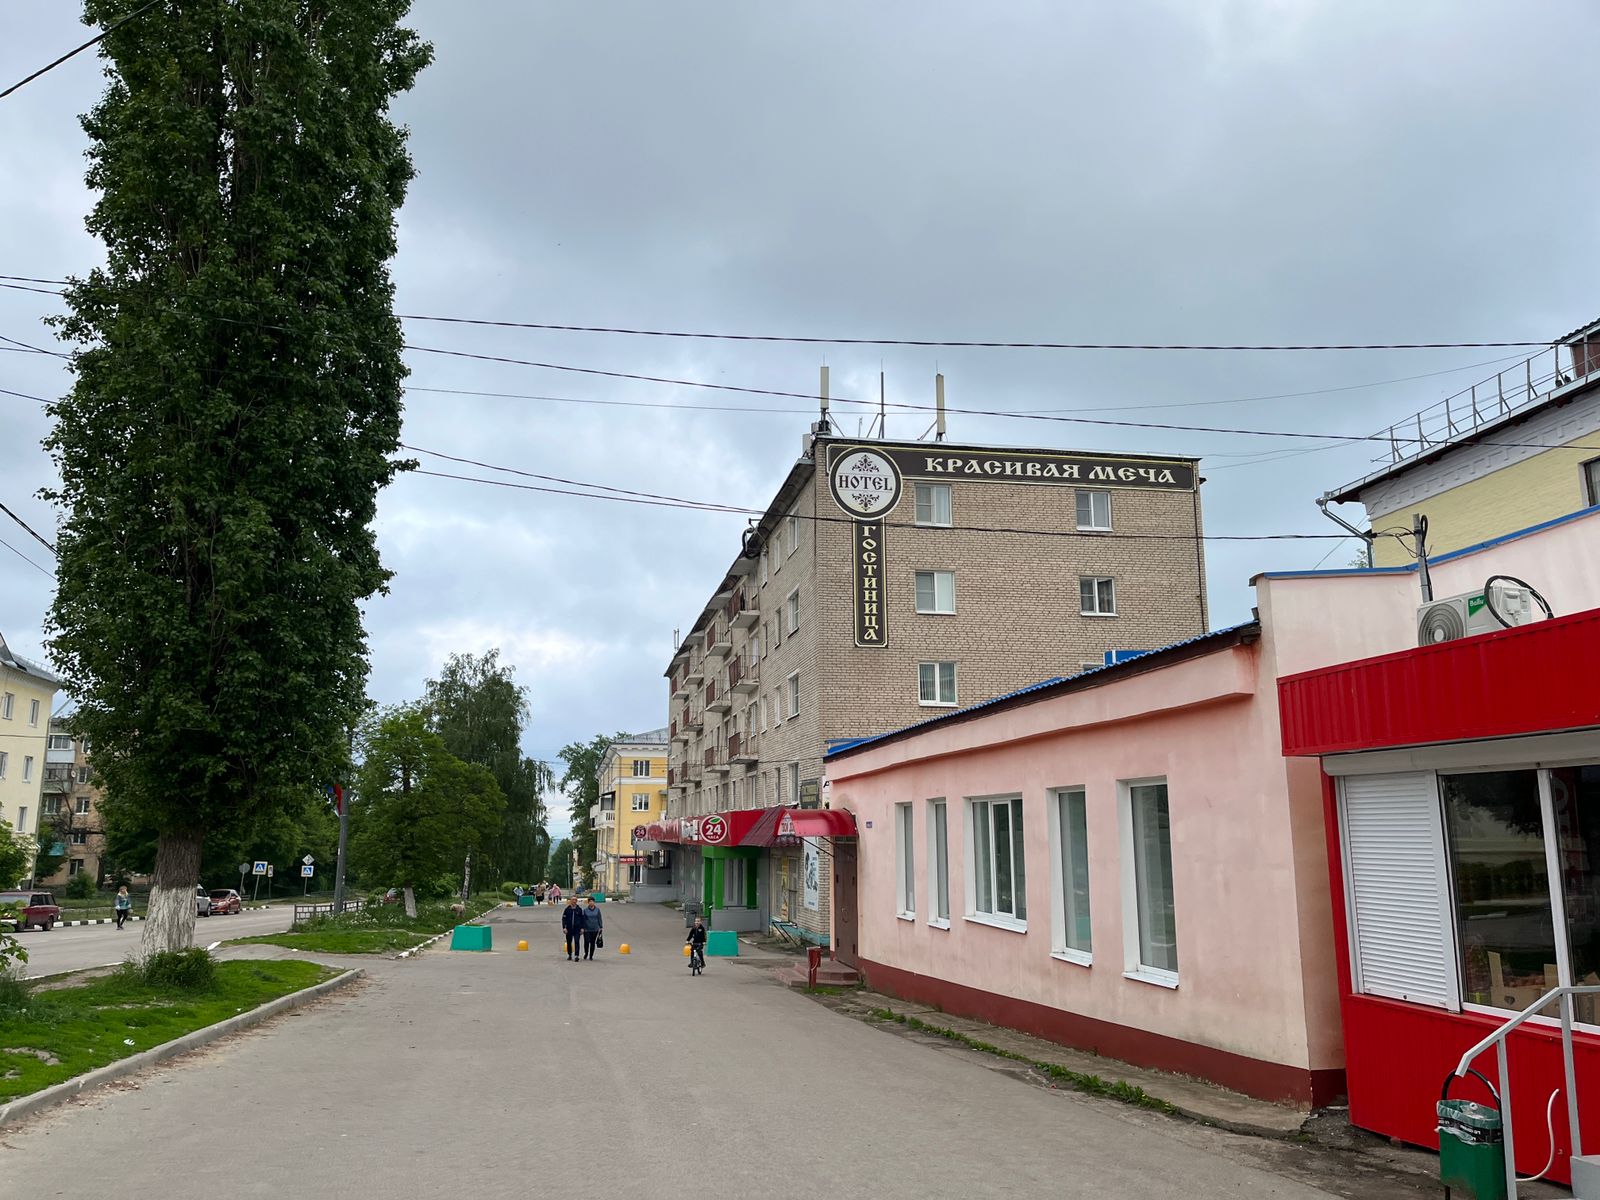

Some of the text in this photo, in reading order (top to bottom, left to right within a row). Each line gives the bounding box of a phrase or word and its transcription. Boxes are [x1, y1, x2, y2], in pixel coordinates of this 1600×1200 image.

[924, 457, 1176, 484] КРАСИВАЯ МЕЧА
[838, 475, 893, 491] HOTEL
[862, 525, 879, 640] ГОСТИНИЦА
[705, 824, 722, 836] 24
